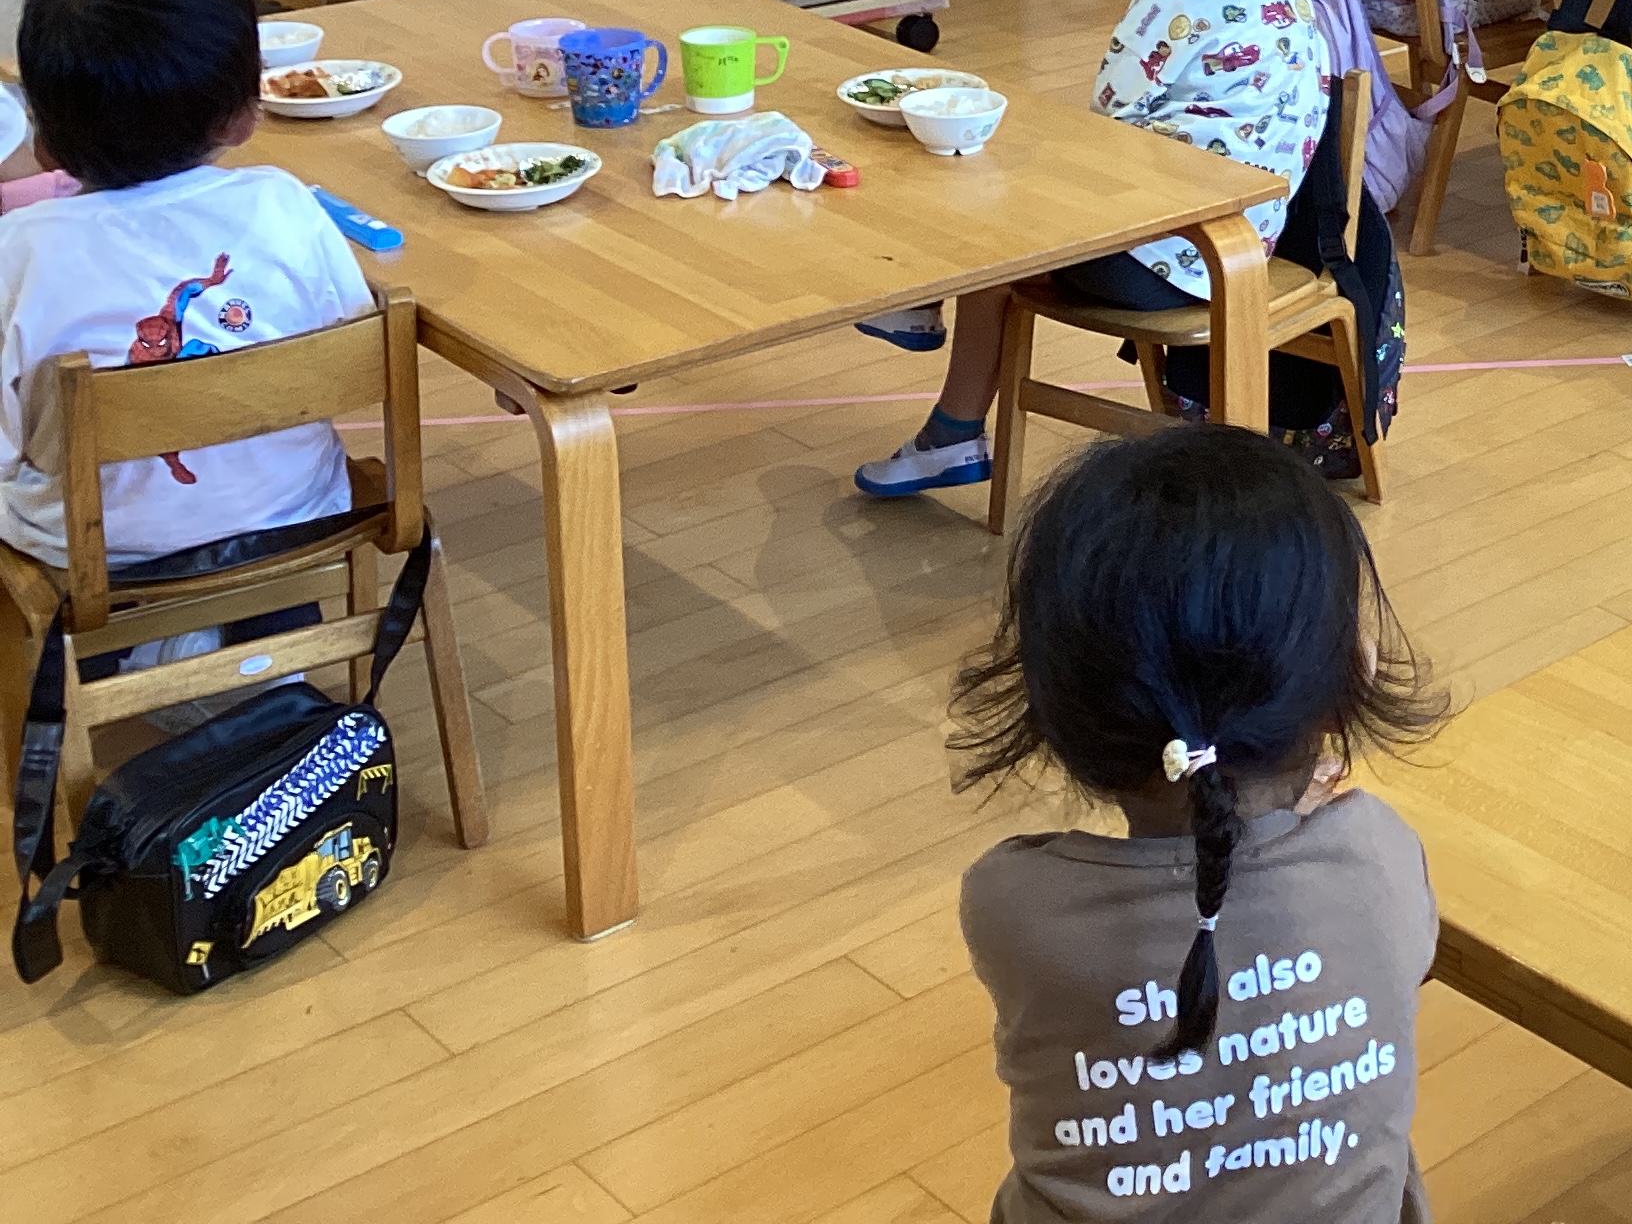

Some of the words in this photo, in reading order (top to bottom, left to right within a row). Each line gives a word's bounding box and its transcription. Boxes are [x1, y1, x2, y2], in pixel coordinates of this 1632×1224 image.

[1115, 980, 1179, 1026] Sh
[1227, 949, 1323, 1002] also
[1218, 995, 1369, 1066] nature
[1054, 1101, 1139, 1147] and
[1152, 1093, 1235, 1137] her
[1249, 1038, 1398, 1119] friends
[1106, 1149, 1192, 1197] and
[1204, 1118, 1361, 1178] family.
